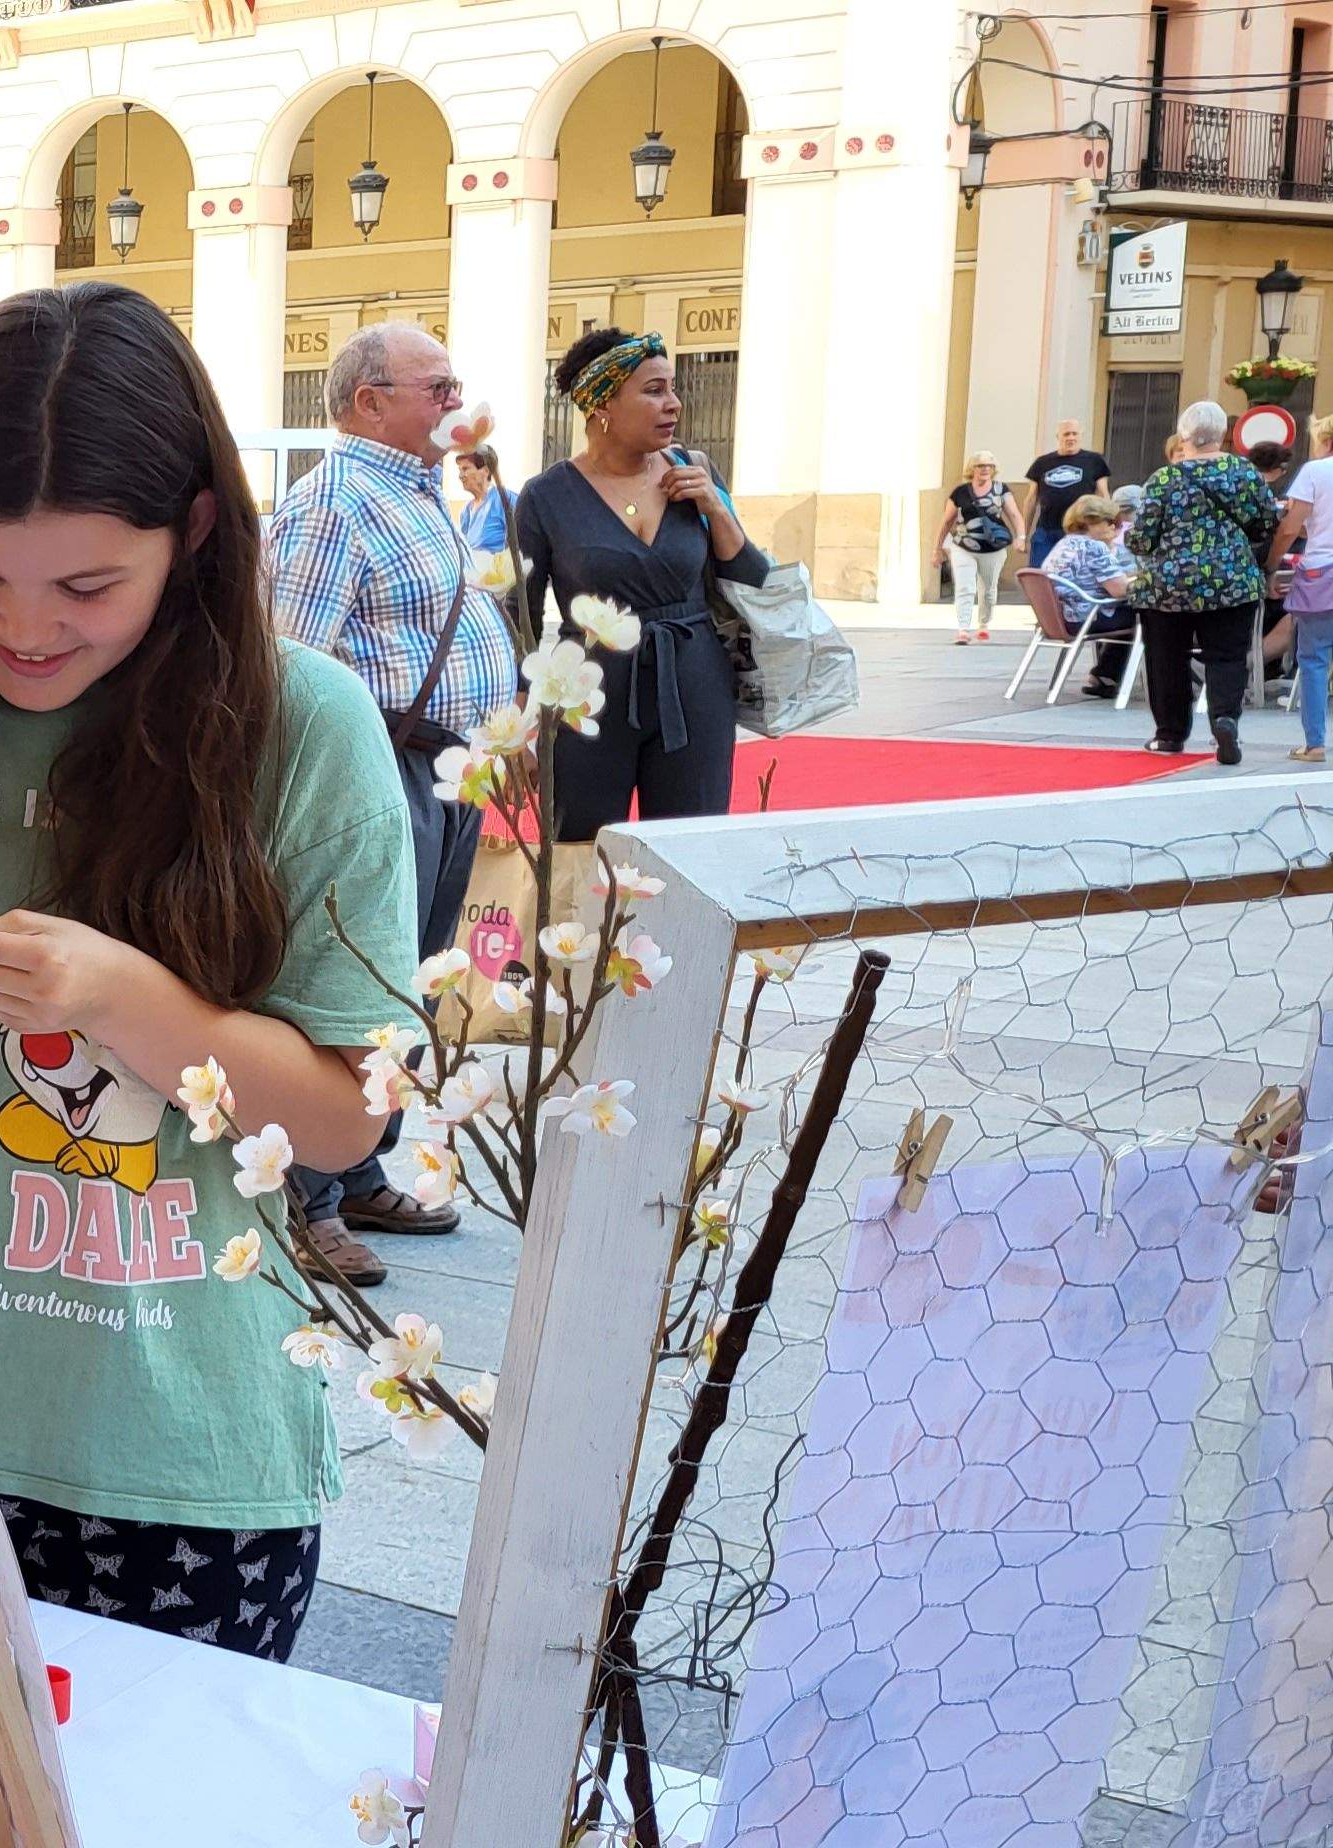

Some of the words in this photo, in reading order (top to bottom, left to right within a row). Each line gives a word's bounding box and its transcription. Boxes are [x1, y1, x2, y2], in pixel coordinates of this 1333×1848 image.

[1119, 271, 1173, 285] VELTINS
[686, 307, 738, 333] CONF
[1136, 315, 1174, 327] Berlin
